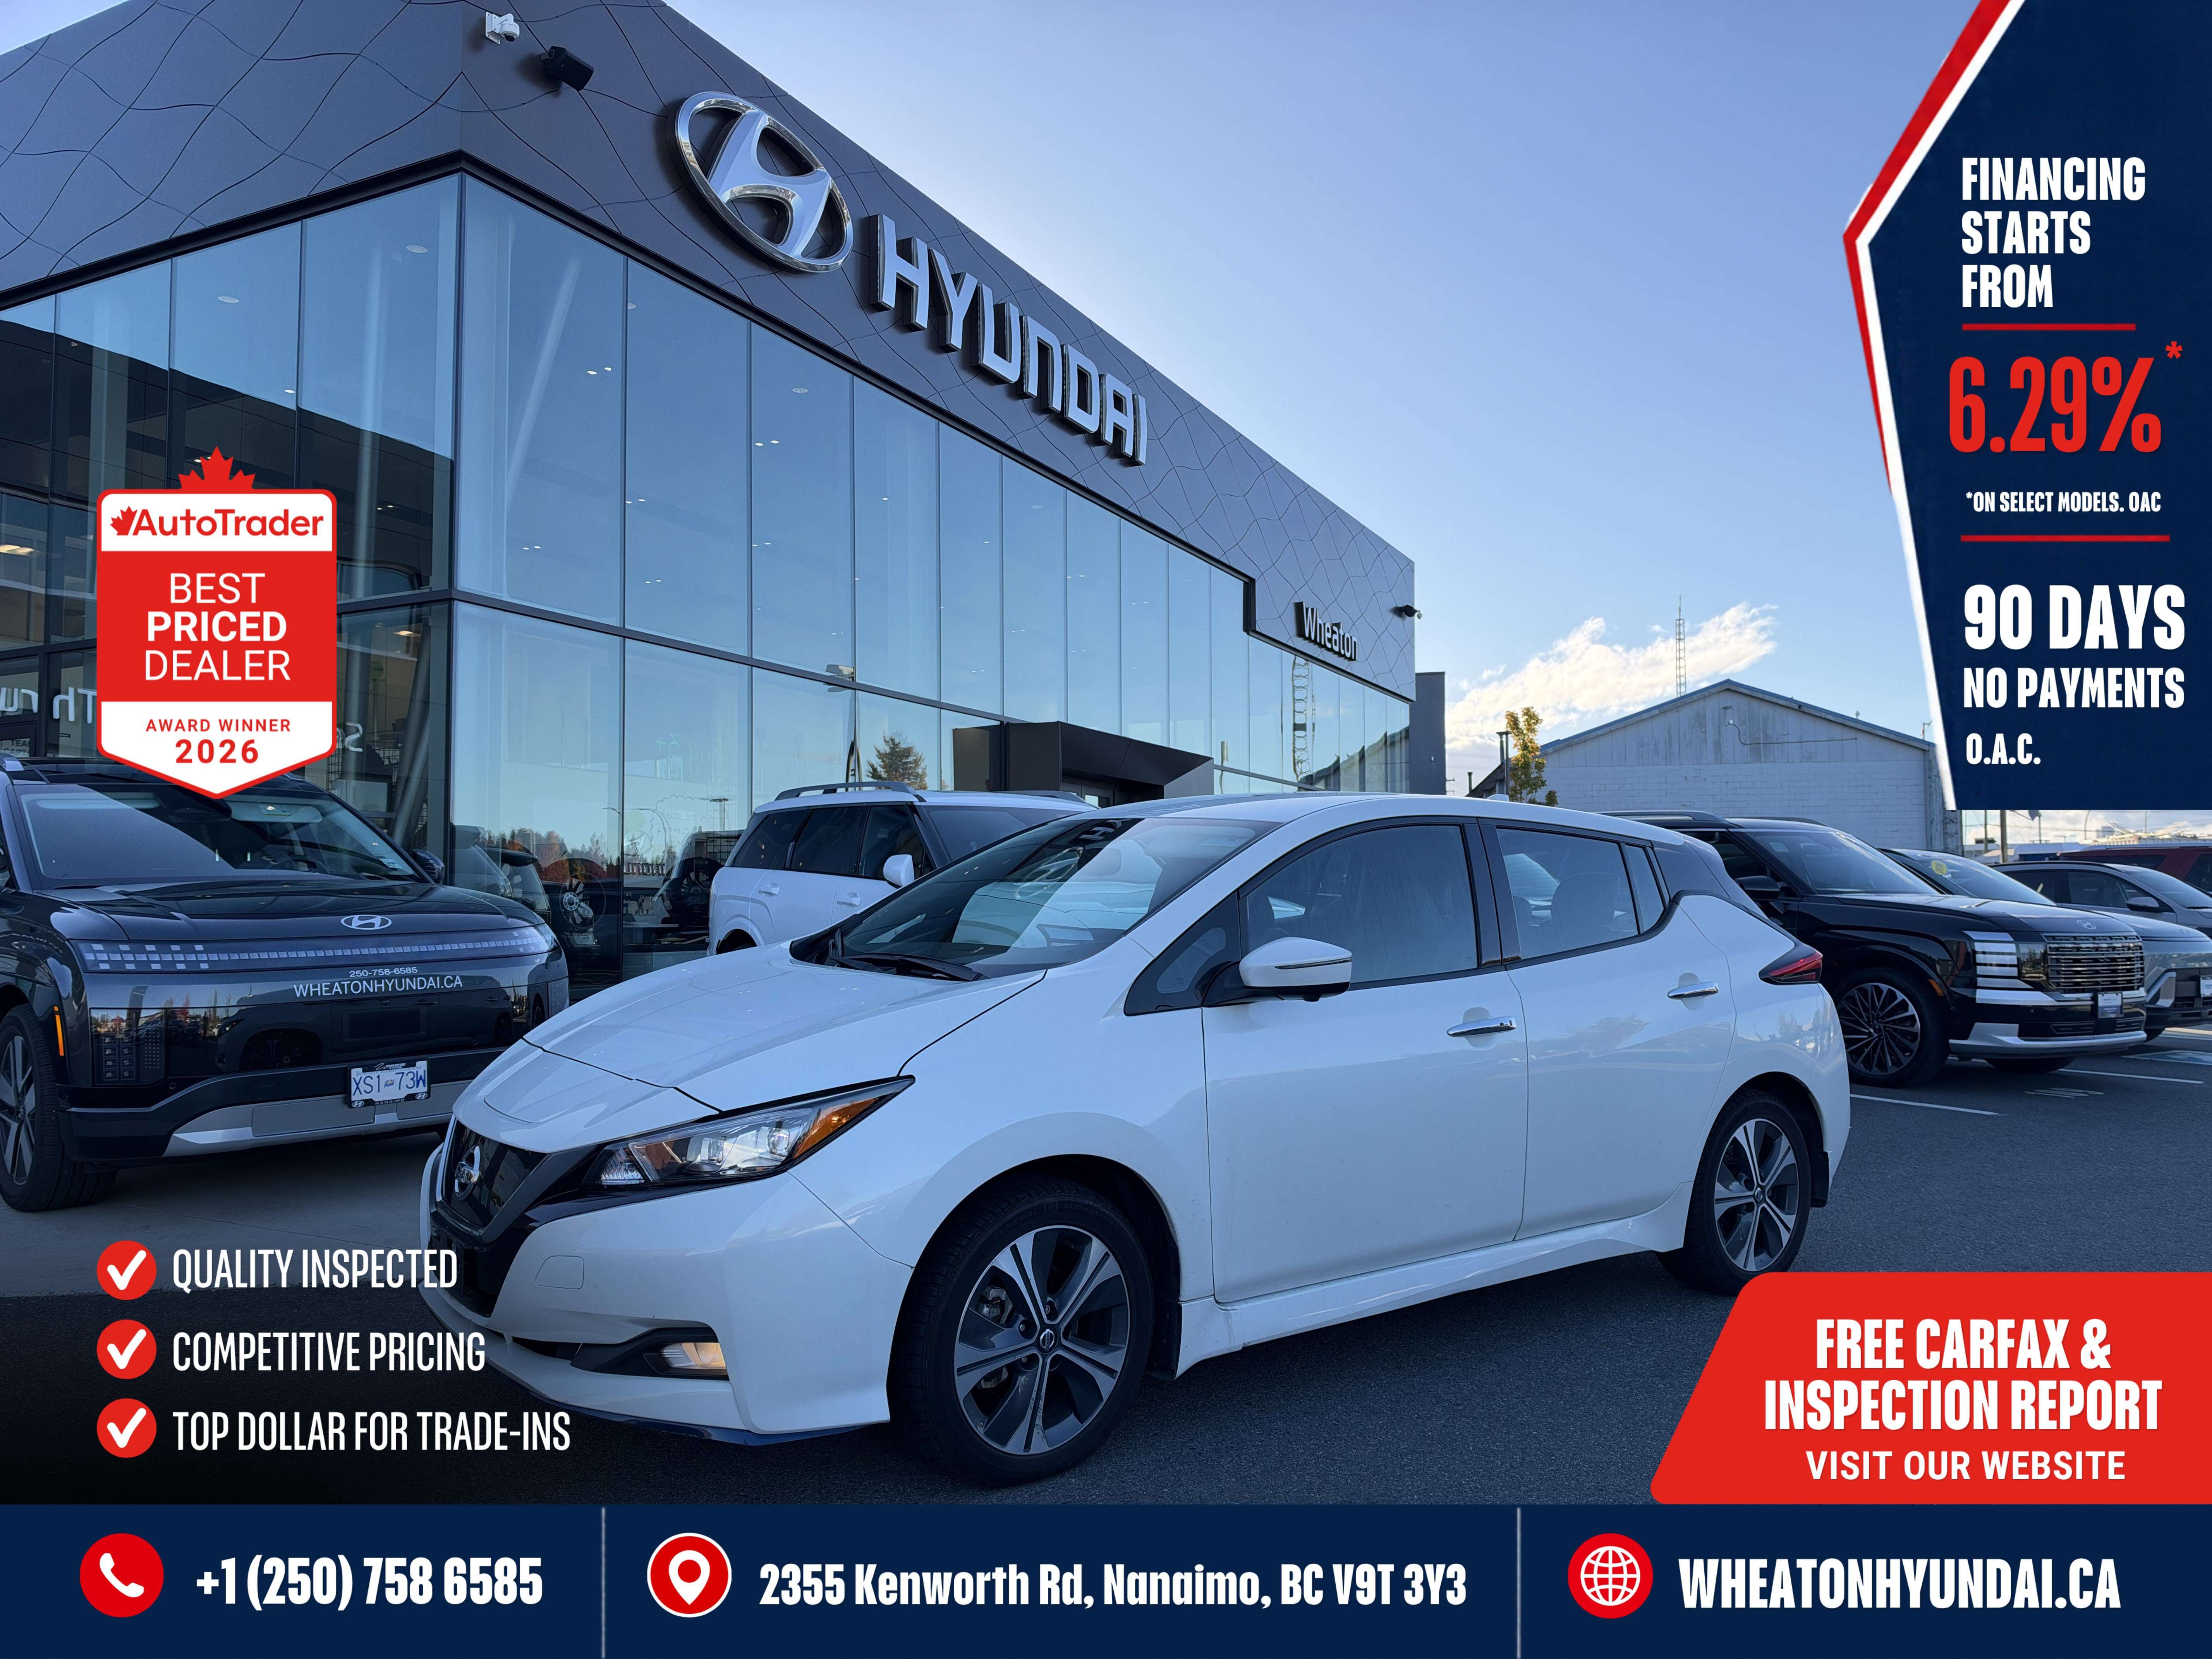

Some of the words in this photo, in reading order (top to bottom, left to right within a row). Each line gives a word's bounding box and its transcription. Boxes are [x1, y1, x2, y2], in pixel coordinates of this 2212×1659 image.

[872, 213, 1147, 467] HYUNDAI
[1302, 601, 1358, 661] Wheaton
[349, 967, 418, 977] 250-758-6585
[294, 975, 463, 998] WHEATONHYUNDAI.CA
[352, 1074, 380, 1096] XS1
[395, 1069, 426, 1091] 73W
